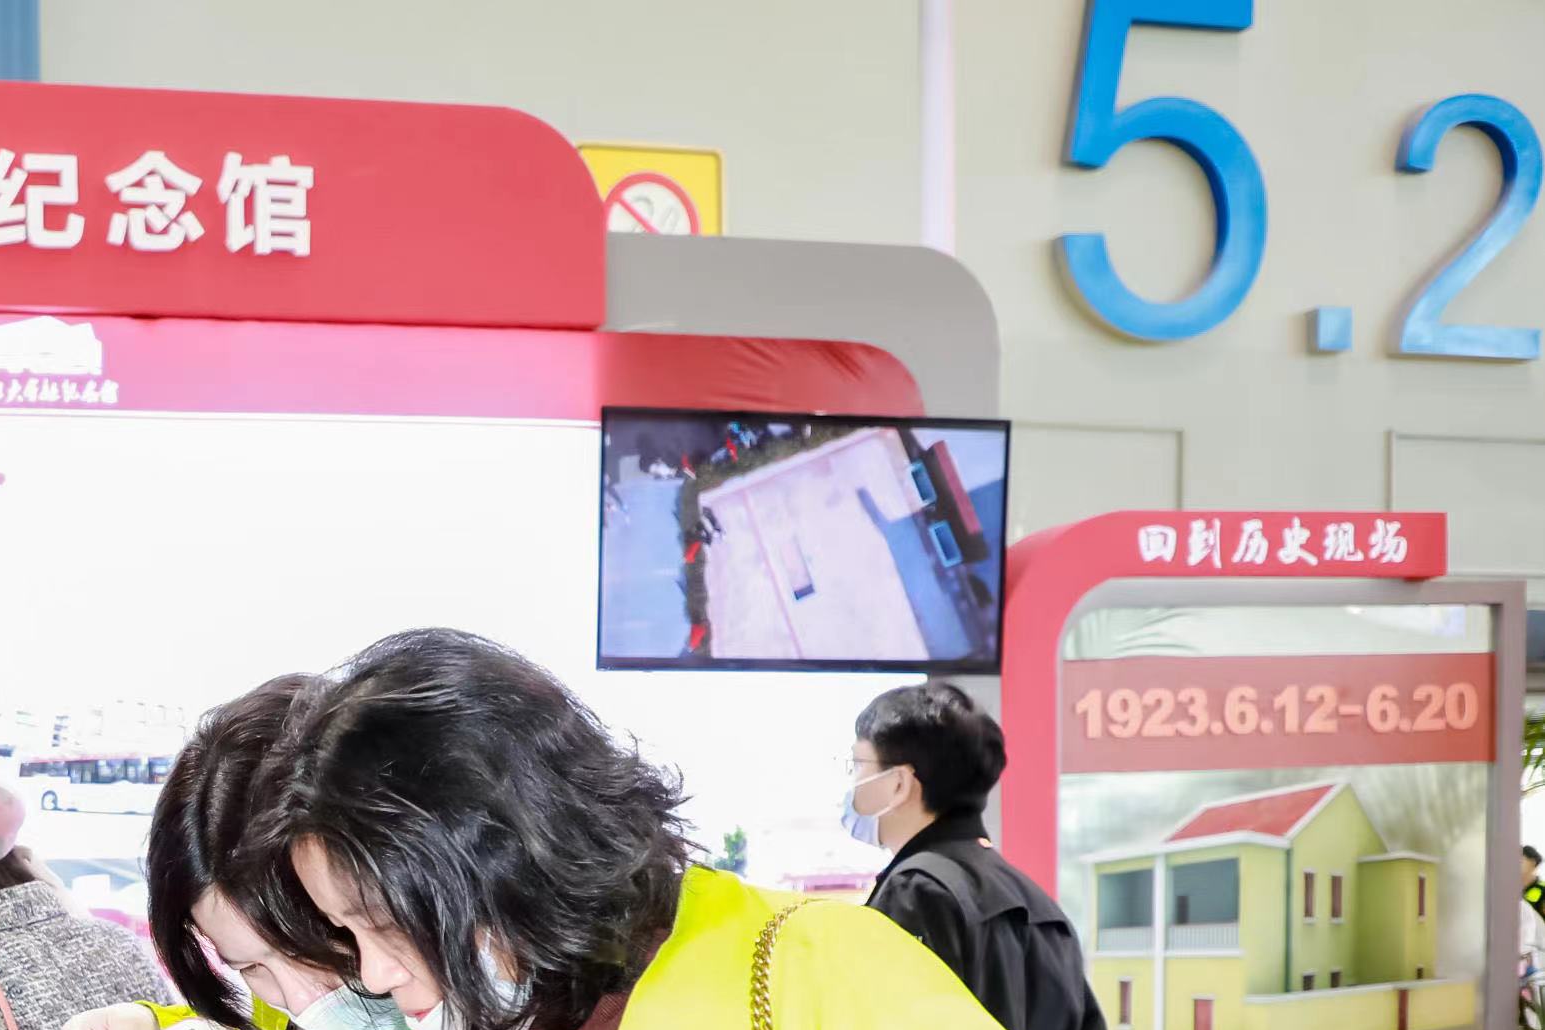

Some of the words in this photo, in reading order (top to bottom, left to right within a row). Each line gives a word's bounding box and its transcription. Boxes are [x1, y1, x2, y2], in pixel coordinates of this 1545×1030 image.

[1054, 0, 1543, 361] 5.2
[1137, 516, 1408, 569] 回到历史现场
[1074, 681, 1480, 740] 1923.6.12-6.20
